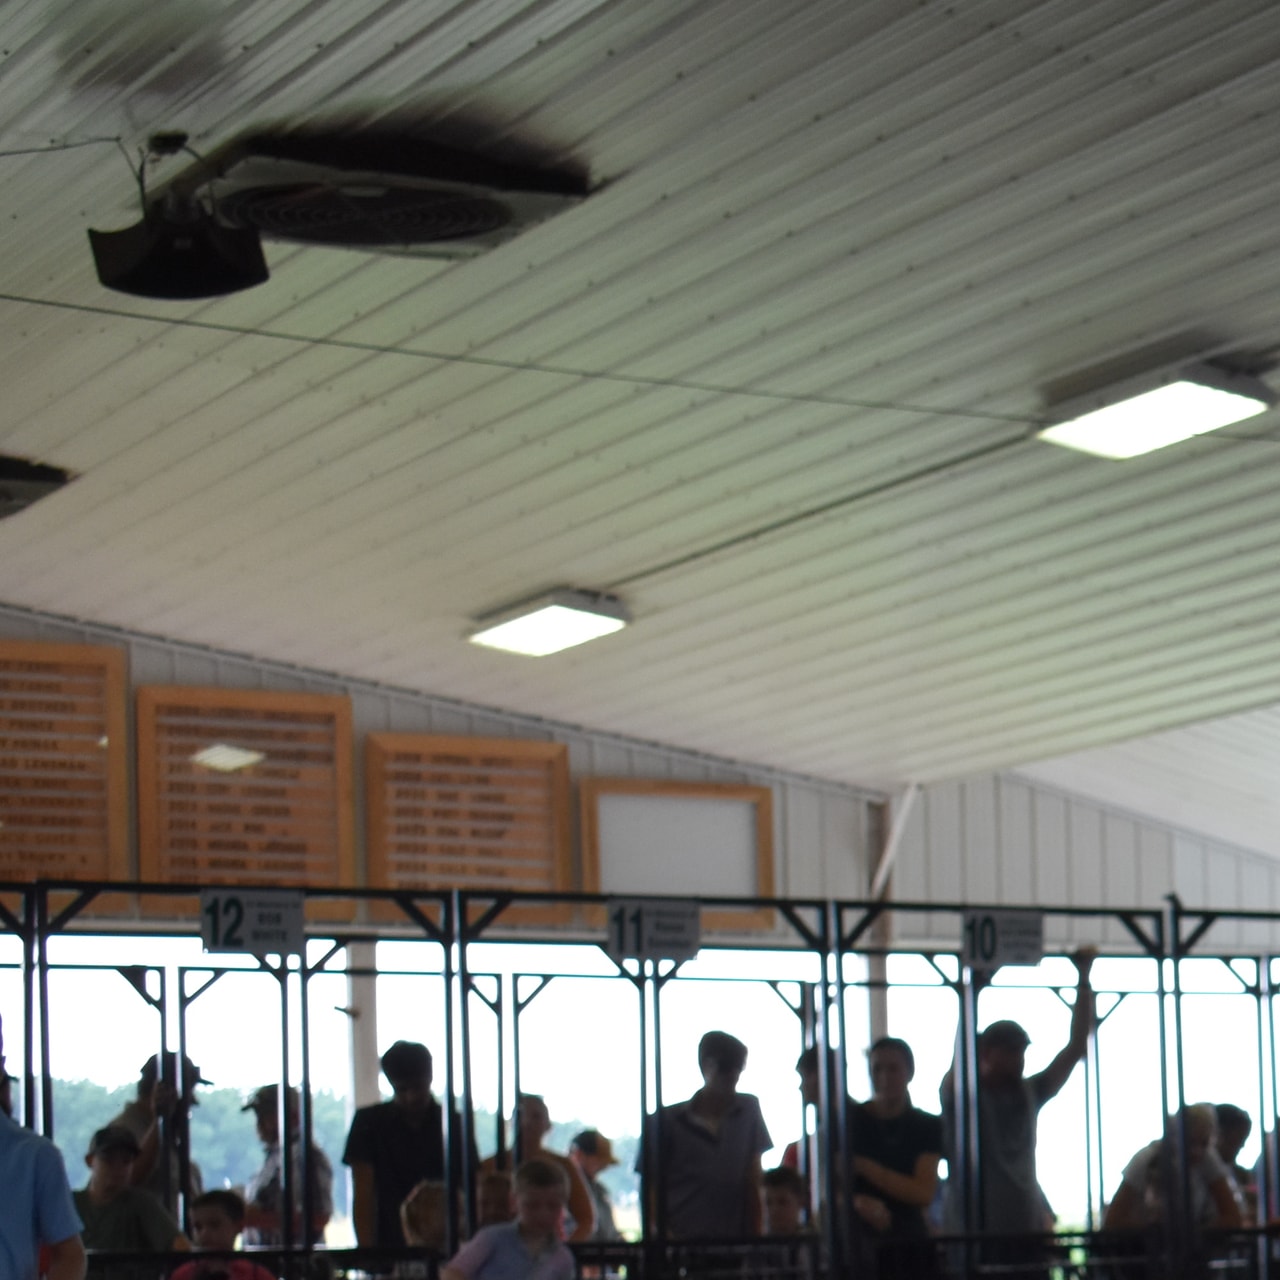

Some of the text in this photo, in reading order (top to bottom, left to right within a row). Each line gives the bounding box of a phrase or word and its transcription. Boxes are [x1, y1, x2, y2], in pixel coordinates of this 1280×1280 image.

[204, 896, 244, 948] 12
[612, 905, 642, 954] 11
[965, 916, 996, 961] 10
